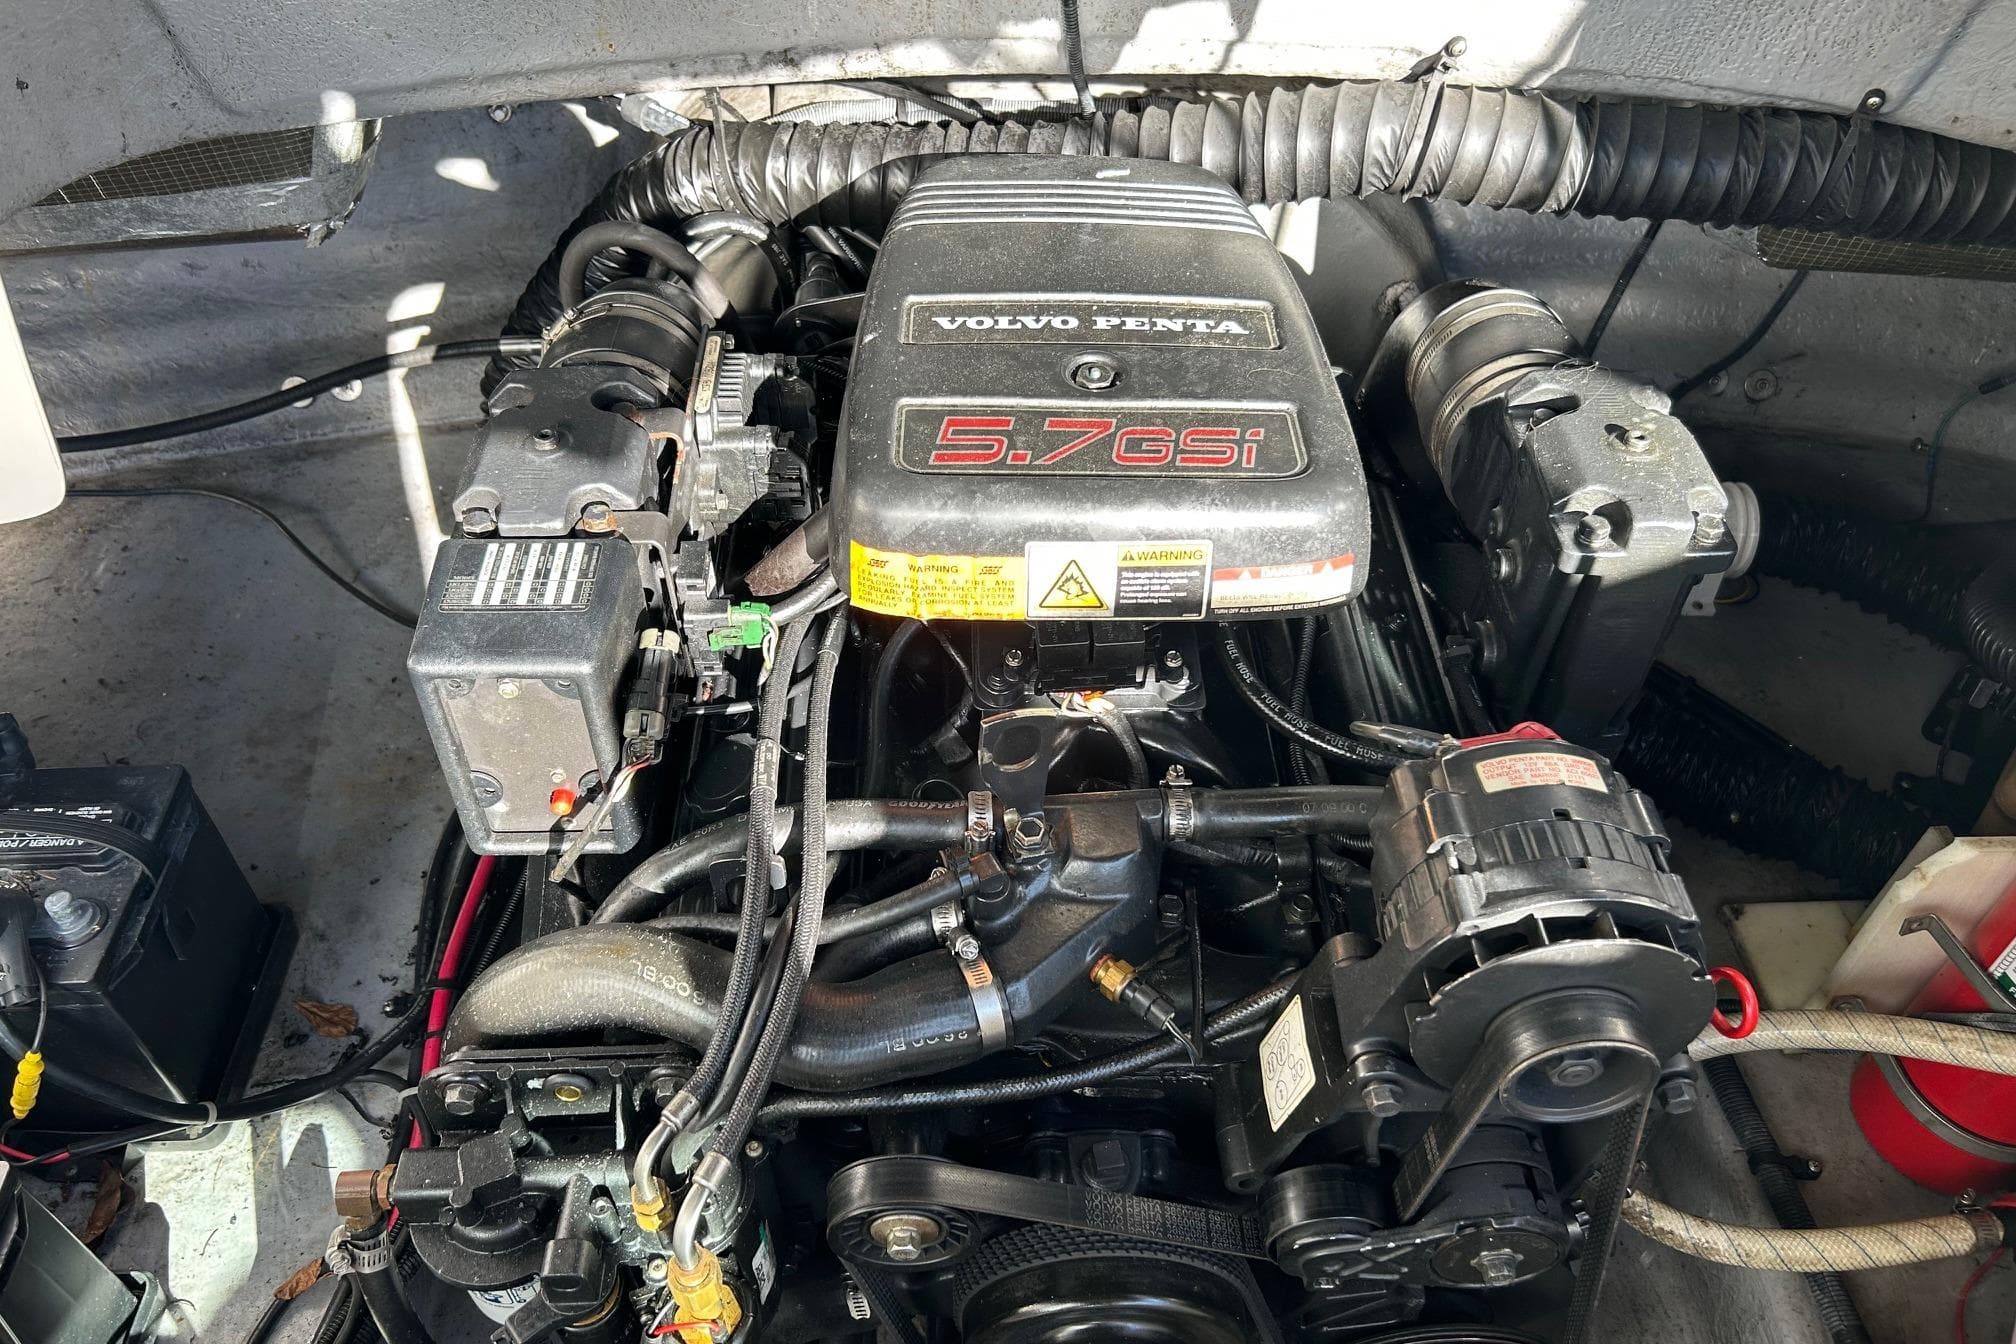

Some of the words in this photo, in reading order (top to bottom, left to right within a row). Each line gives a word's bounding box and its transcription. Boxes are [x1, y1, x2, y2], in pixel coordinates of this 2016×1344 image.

[931, 315, 1079, 331] VOLVO
[1092, 316, 1250, 335] PENTA
[1136, 549, 1203, 561] WARNING
[857, 566, 896, 582] LEAKING
[903, 576, 927, 585] FUEL
[908, 563, 959, 574] WARNING
[857, 574, 902, 590] EXPLOSION
[903, 583, 937, 593] HAZARD
[941, 584, 977, 593] INSPECT
[857, 581, 905, 597] REGULARLY
[911, 590, 949, 600] EXAMINE
[857, 588, 873, 597] FOR
[875, 592, 903, 603] LEAKS
[920, 598, 971, 607] CORROSION
[857, 594, 899, 609] ANNUALLY
[1224, 639, 1238, 660] FUEL
[1235, 661, 1254, 684] HOSE
[1260, 693, 1281, 713] FUEL
[1284, 712, 1310, 732] HOSE
[1324, 735, 1350, 751] FUEL
[1355, 745, 1384, 760] HOSE
[1481, 759, 1507, 769] VOLVO
[1484, 769, 1520, 780] VENDOR
